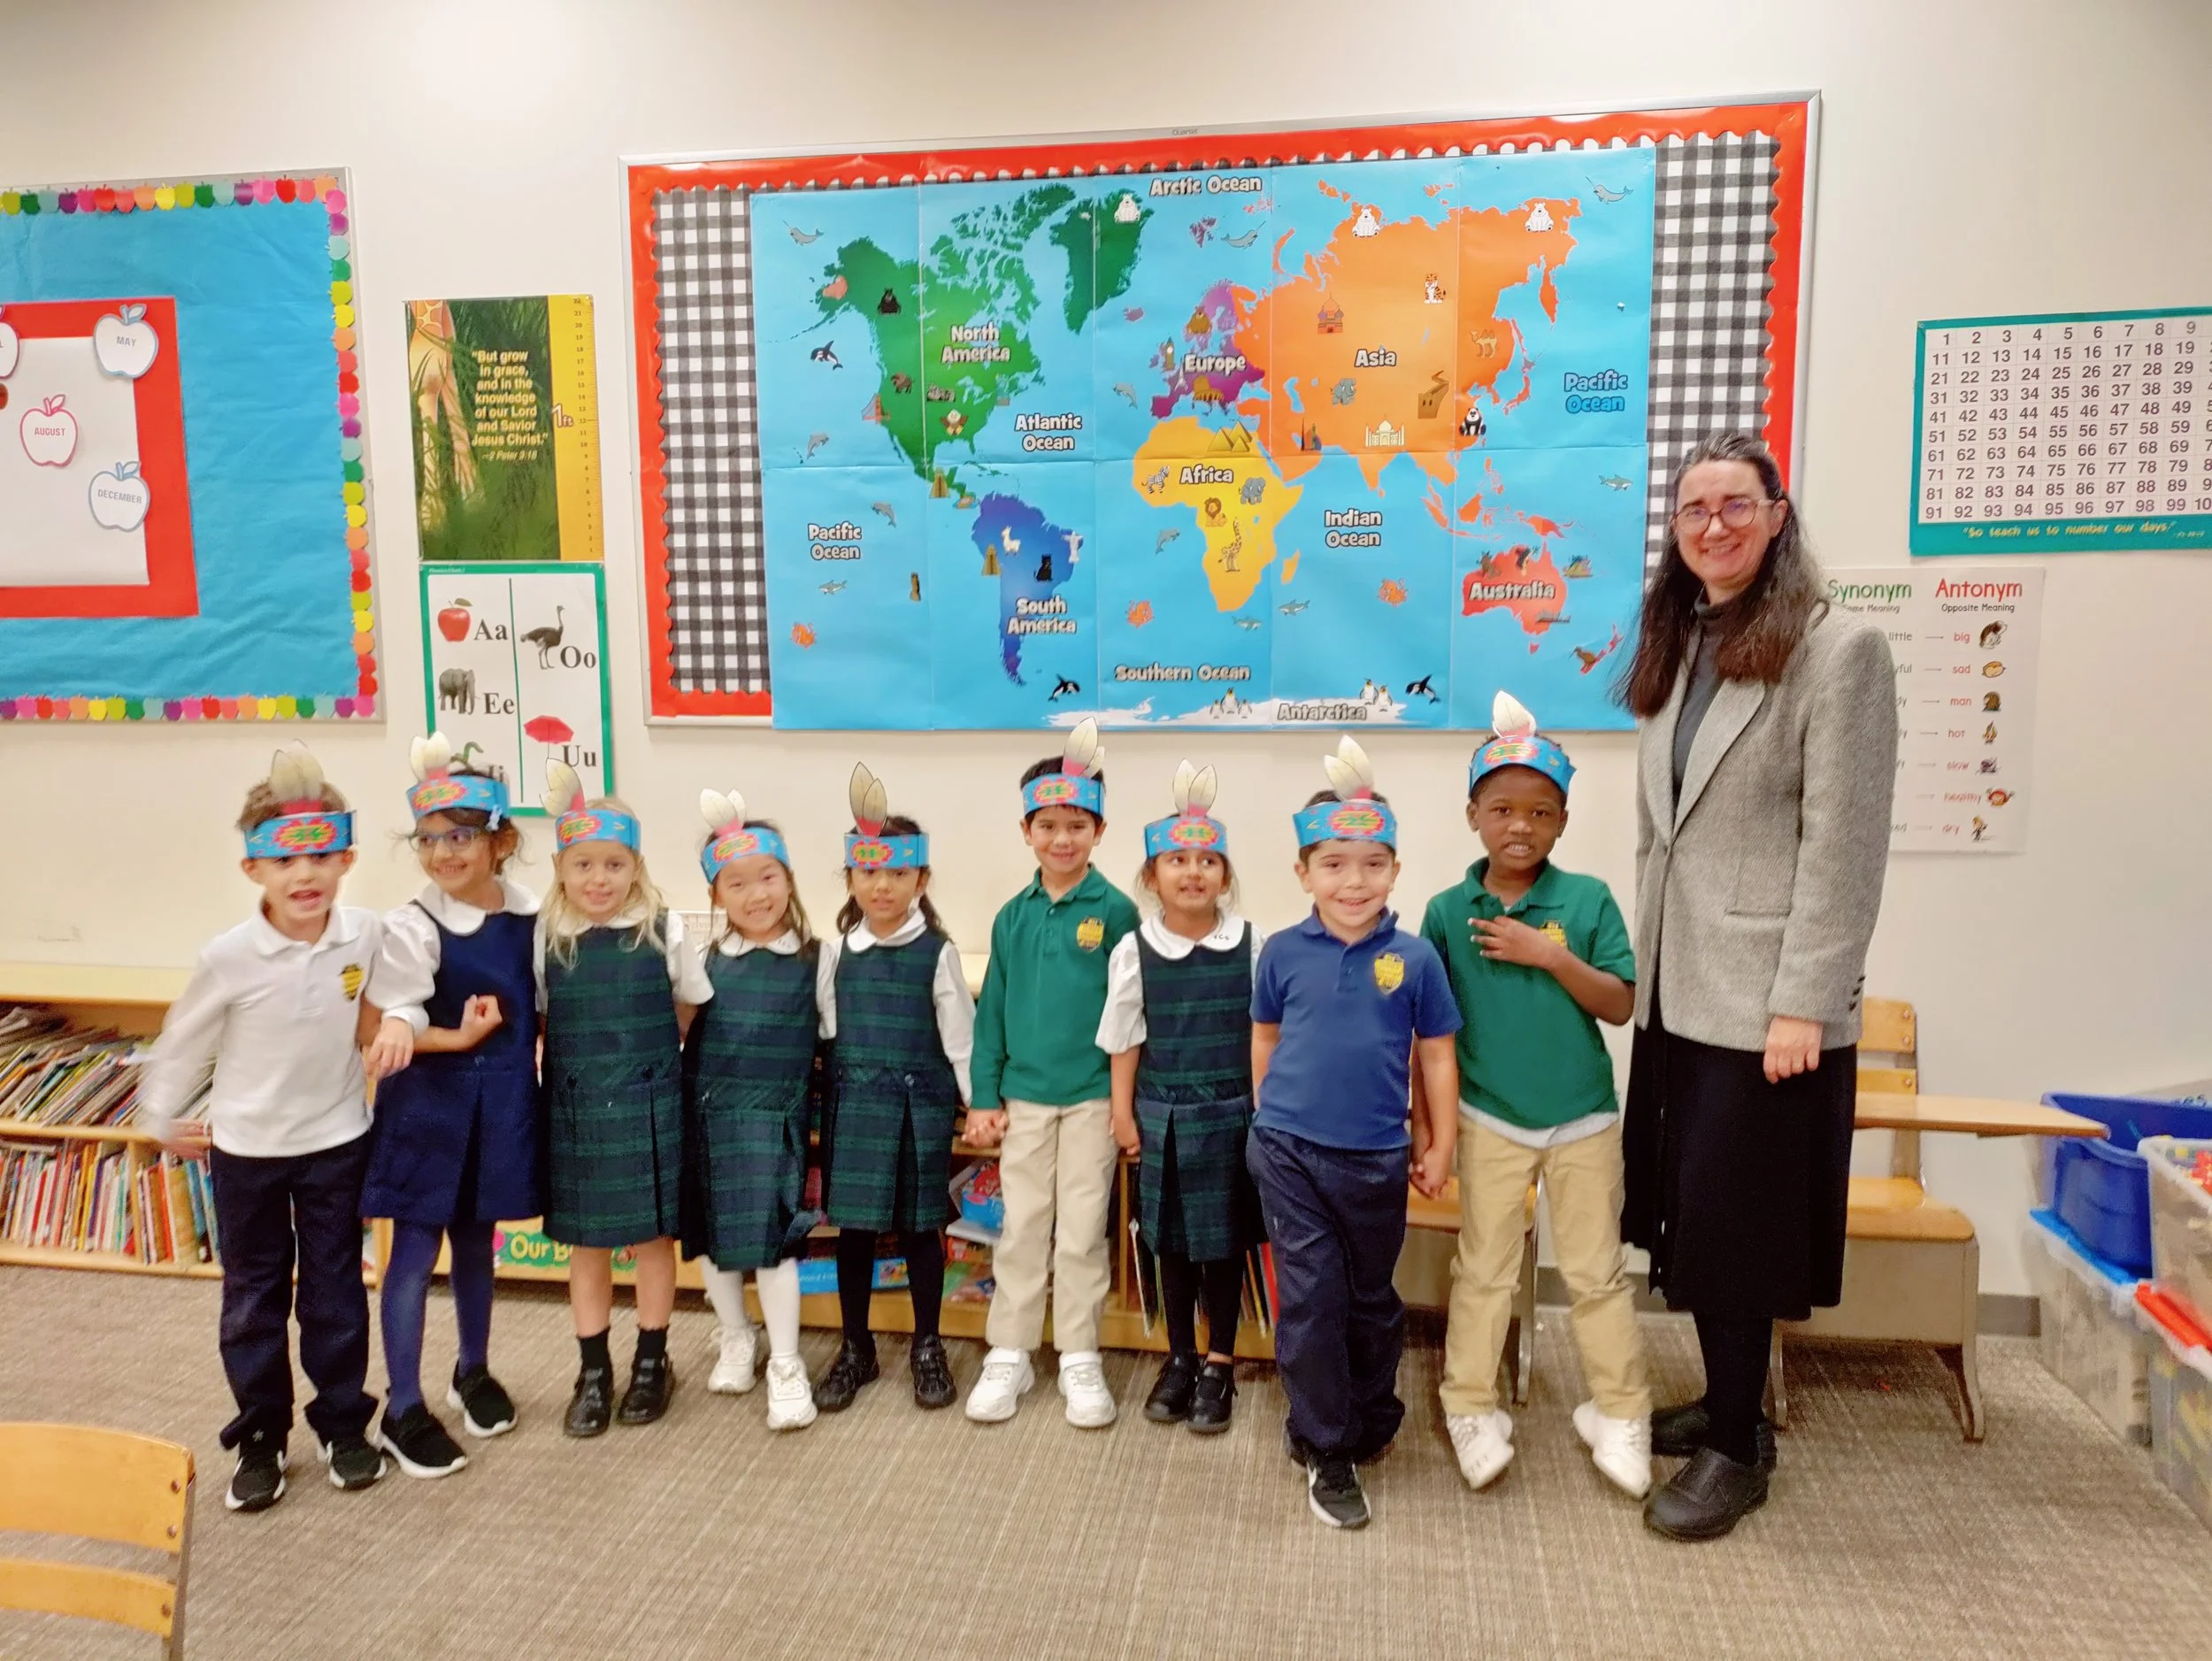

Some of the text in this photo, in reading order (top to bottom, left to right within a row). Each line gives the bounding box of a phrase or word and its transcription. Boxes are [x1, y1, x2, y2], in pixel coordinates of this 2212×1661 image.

[1149, 175, 1263, 195] Arctic Ocean
[950, 319, 1000, 342] North
[1943, 320, 2196, 346] 1 2 3 4 5 6 7 8 9
[116, 335, 137, 347] MAY
[500, 351, 528, 365] grow
[941, 345, 1011, 363] America
[1354, 345, 1396, 367] Asia
[1932, 341, 2195, 366] 11 12 13 14 15 16 17 18 19
[480, 365, 528, 379] in grace,
[1185, 353, 1247, 377] Europe
[1931, 360, 2194, 386] 21 22 23 24 25 26 27 28 29
[476, 378, 533, 391] and in the
[1563, 369, 1629, 392] Pacific
[474, 392, 536, 405] knowledge
[1930, 381, 2193, 405] 31 32 33 34 35 36 37 38 39
[475, 405, 537, 419] of our Lord
[1565, 395, 1625, 414] Ocean
[1929, 400, 2192, 424] 41 42 43 44 45 46 47 48 49
[34, 427, 65, 436] AUGUST
[477, 419, 536, 432] and Savior
[1014, 412, 1083, 432] Atlantic
[1928, 419, 2191, 443] 51 52 53 54 55 56 57 58 59
[471, 433, 504, 446] Jesus
[1022, 434, 1075, 452] Ocean
[1927, 439, 2190, 463] 61 62 63 64 65 66 67 68 69
[1179, 464, 1233, 485] Africa
[1927, 458, 2189, 481] 71 72 73 74 75 76 77 78 79
[97, 488, 142, 504] DECEMBER
[1926, 478, 2187, 501] 81 82 83 84 85 86 87 88 89
[1325, 508, 1382, 527] Indian
[808, 520, 863, 541] Pacific
[1325, 530, 1381, 549] Ocean
[810, 543, 861, 560] Ocean
[1469, 580, 1556, 601] Australia
[1828, 579, 1912, 603] Synonym
[1935, 578, 2023, 603] Antonym
[1016, 595, 1068, 614] South
[1867, 604, 1900, 614] Meaning
[1941, 604, 2015, 613] Opposite Meaning
[474, 619, 508, 641] Aa
[1008, 617, 1077, 635] America
[1888, 632, 1912, 642] little
[1954, 632, 1970, 643] big
[560, 646, 596, 668] Oo
[1115, 662, 1250, 681] Southern Ocean
[1953, 665, 1970, 673] sad
[484, 693, 515, 714] Ee
[1950, 697, 1972, 706] man
[1277, 703, 1368, 720] Antarctica
[1948, 729, 1966, 738] hot
[562, 745, 596, 767] Uu
[511, 1234, 550, 1259] Our
